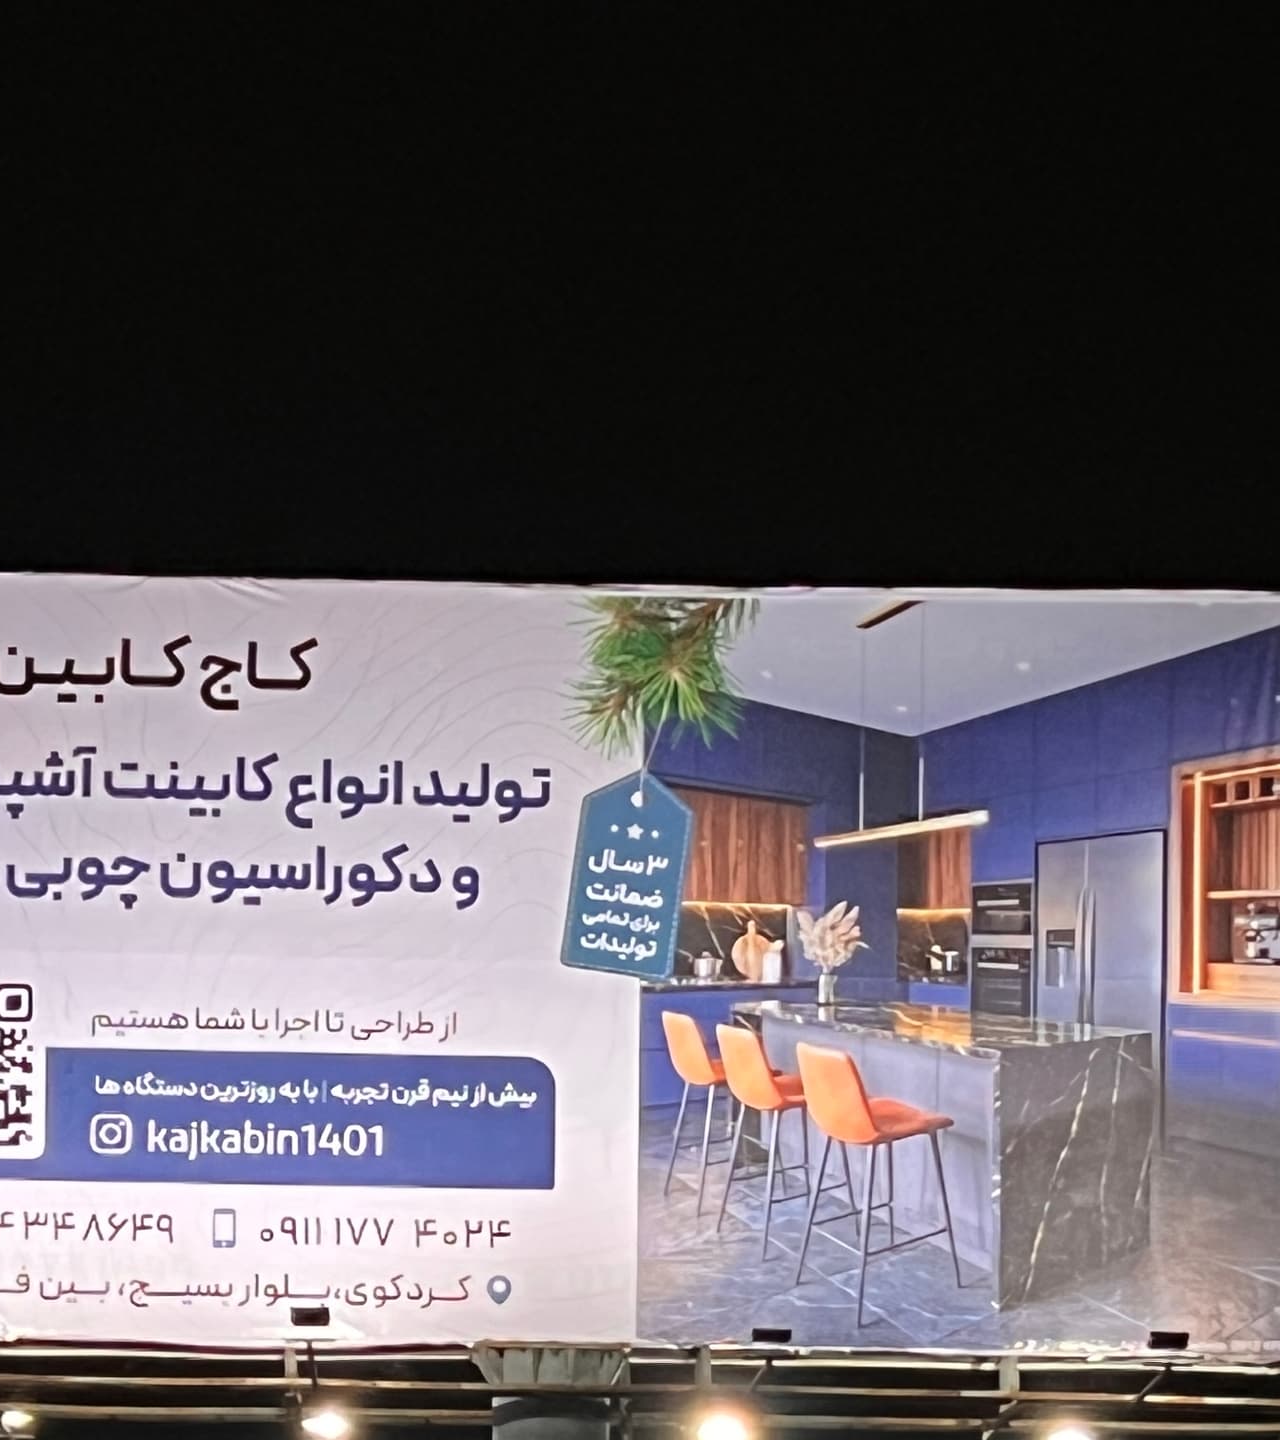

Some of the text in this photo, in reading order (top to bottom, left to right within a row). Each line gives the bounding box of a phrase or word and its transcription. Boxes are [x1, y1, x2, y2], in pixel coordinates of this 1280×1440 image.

[200, 637, 318, 711] کاج
[104, 752, 279, 818] کابینت
[285, 758, 404, 829] انواع
[412, 763, 552, 823] تولید
[160, 843, 442, 907] دکوراسیون
[588, 848, 645, 874] سال
[6, 856, 151, 909] چوبی
[452, 866, 480, 910] و
[585, 883, 664, 908] ضمانت
[91, 1009, 190, 1037] هستیم
[194, 1007, 246, 1031] شما
[274, 1008, 320, 1039] اجرا
[325, 1009, 345, 1033] تا
[351, 1010, 435, 1041] طراحی
[438, 1011, 458, 1042] از
[330, 1082, 390, 1105] تجربه
[391, 1078, 431, 1107] قرن
[431, 1084, 469, 1108] نیم
[470, 1081, 487, 1108] از
[488, 1081, 538, 1109] بیش
[147, 1118, 384, 1161] kajkabin1401
[40, 1276, 110, 1304] بین
